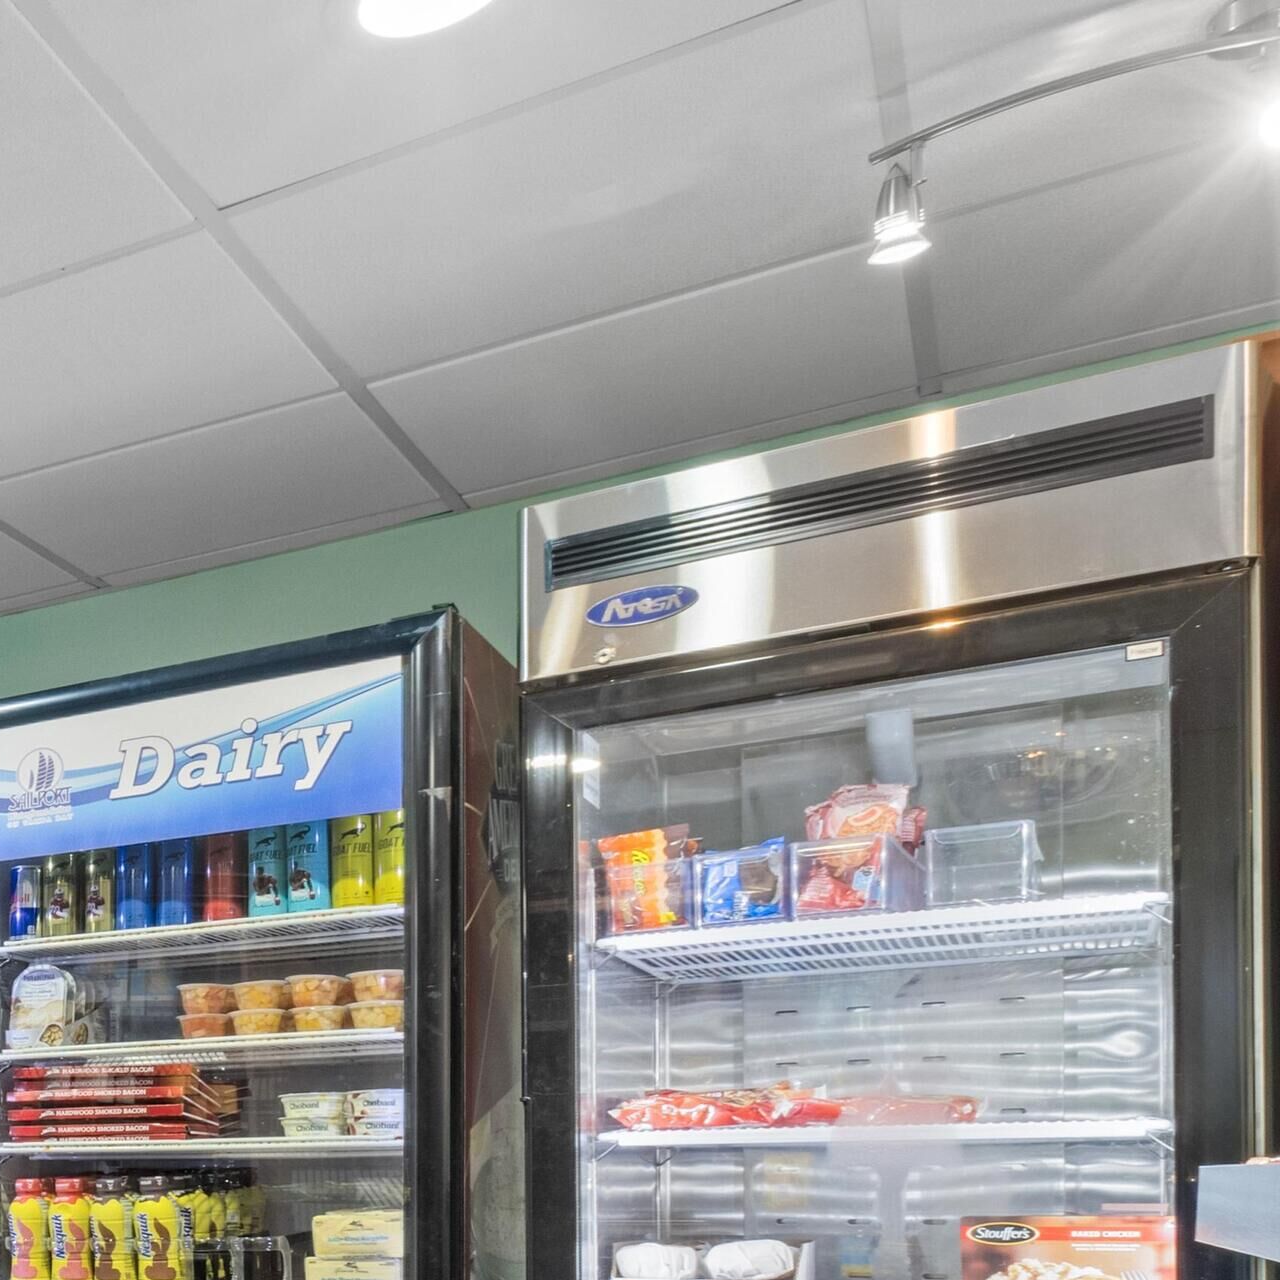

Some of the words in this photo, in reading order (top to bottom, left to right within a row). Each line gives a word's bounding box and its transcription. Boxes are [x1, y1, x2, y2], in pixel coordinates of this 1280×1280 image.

[601, 593, 682, 623] ATOSA
[109, 717, 352, 800] Dairy
[7, 786, 73, 812] SAILPORT
[290, 1102, 320, 1110] Chobani
[363, 1098, 396, 1107] Chobani
[94, 1108, 122, 1116] SMOKED
[123, 1107, 147, 1115] BACON
[57, 1125, 96, 1133] HARDWOOD
[125, 1124, 149, 1132] BACON
[296, 1124, 329, 1132] Chobani
[365, 1121, 400, 1131] Chobani
[51, 1214, 67, 1260] Nesquik
[138, 1212, 152, 1258] Nesquik
[975, 1226, 1032, 1242] Stouffer's
